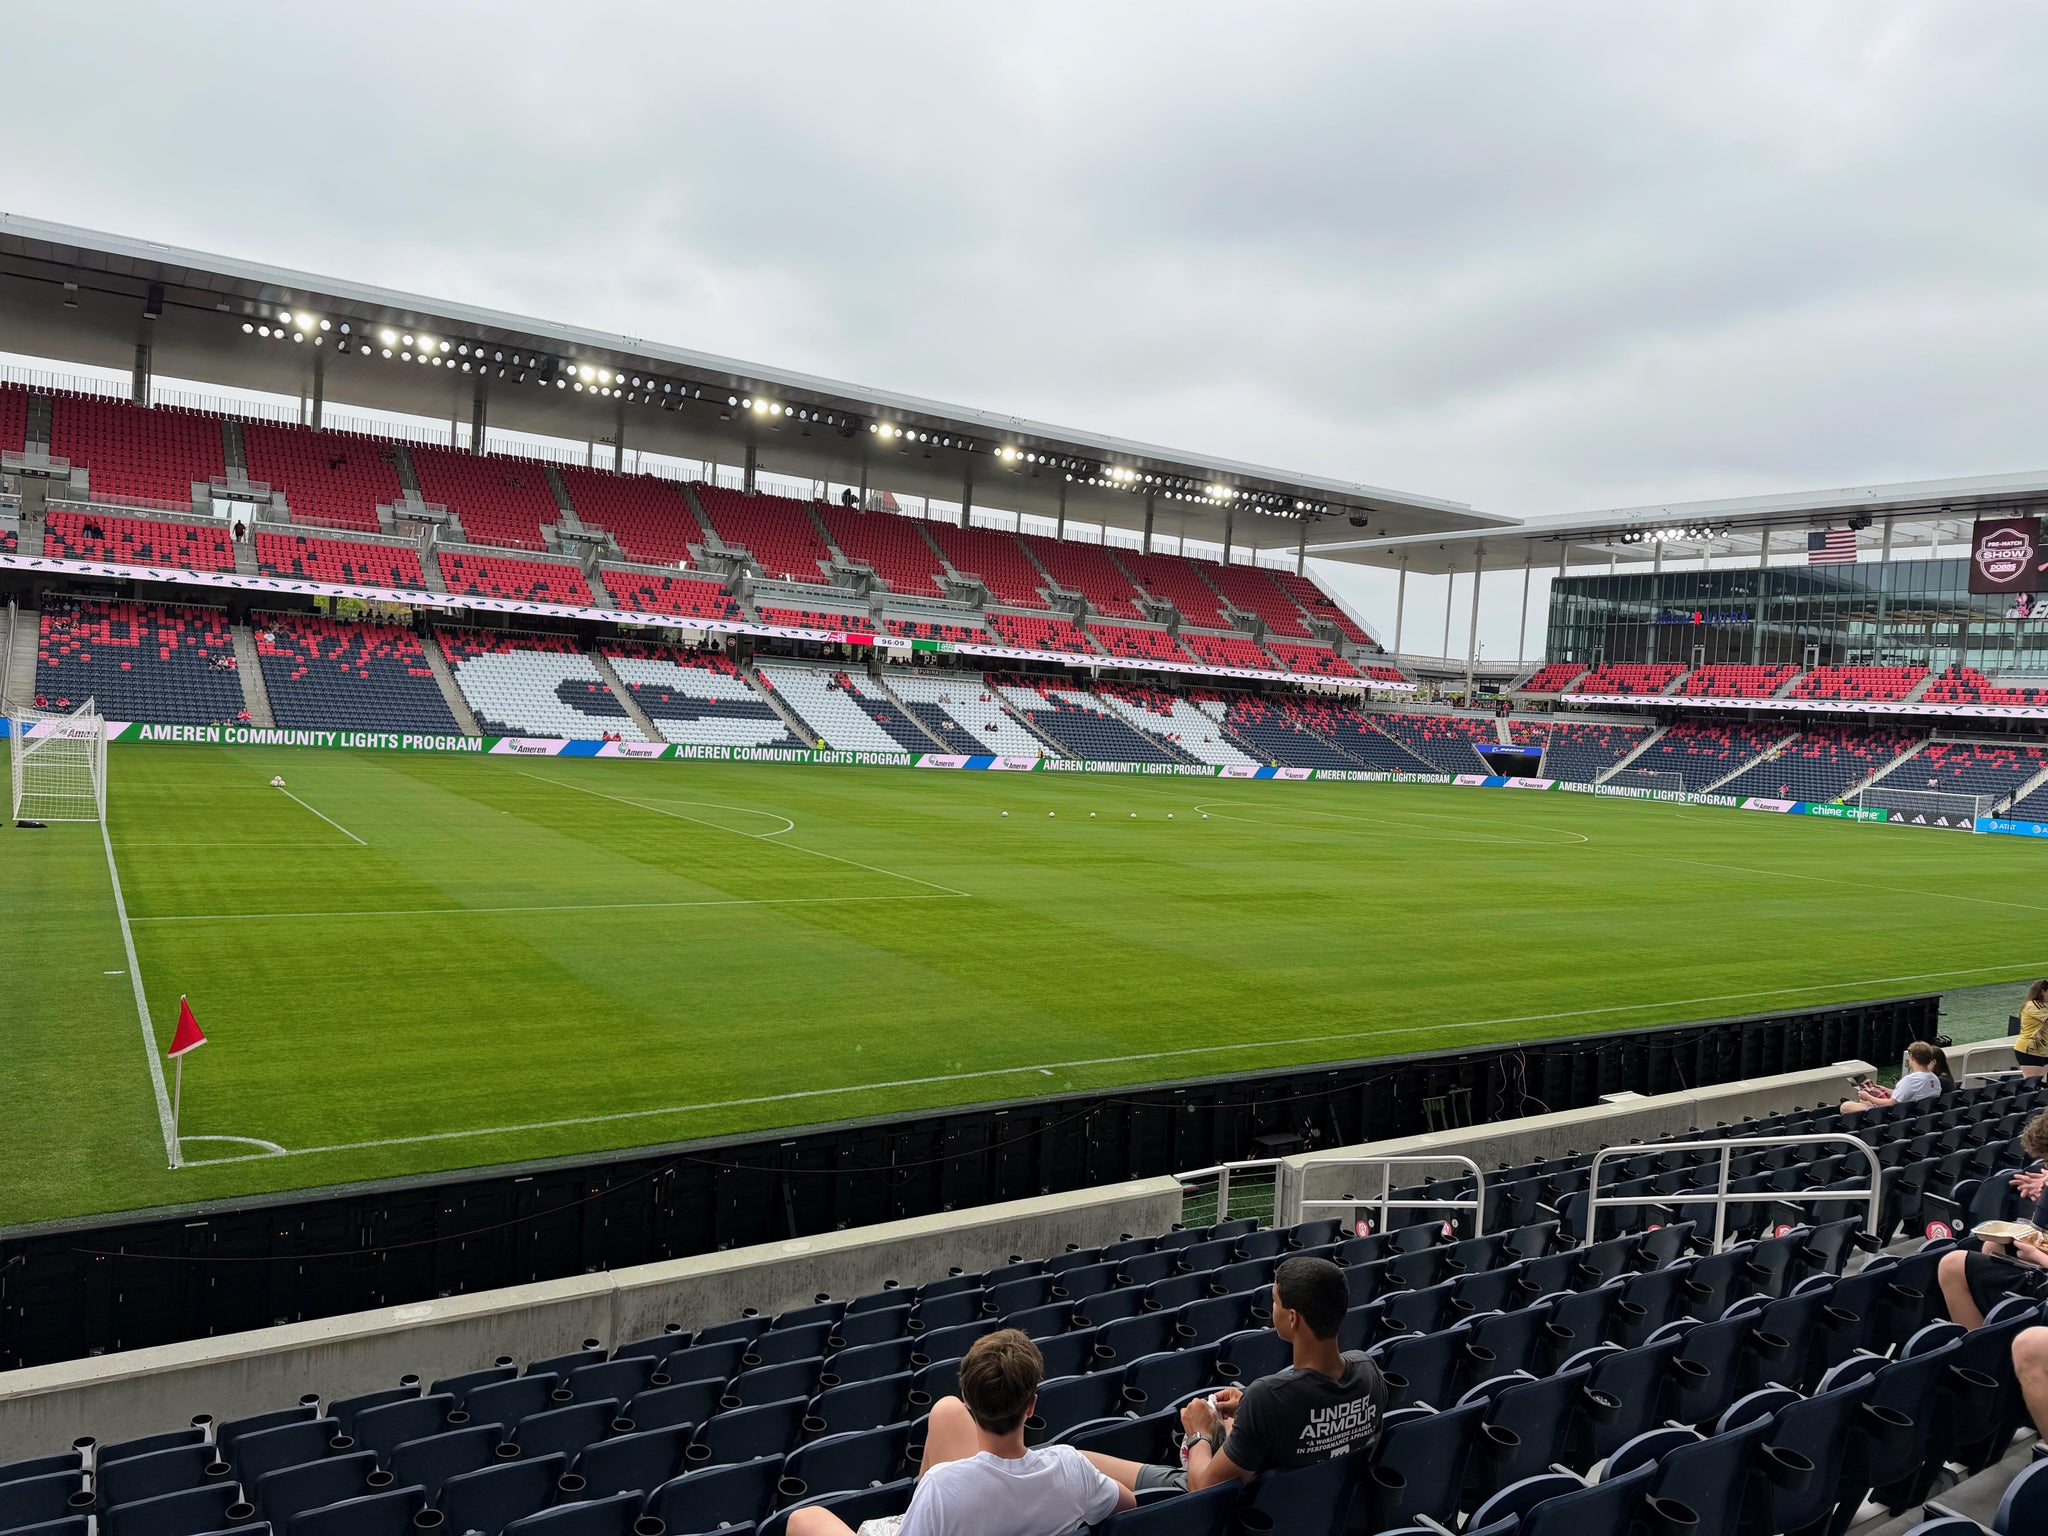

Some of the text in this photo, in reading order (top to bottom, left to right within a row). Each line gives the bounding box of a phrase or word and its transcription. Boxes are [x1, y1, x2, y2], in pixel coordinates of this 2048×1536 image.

[1983, 550, 2026, 559] SHOW
[67, 729, 98, 738] Amee
[140, 724, 483, 751] AMEREN COMMUNITY LIGHTS PROGRAM
[517, 744, 547, 754] Ameren
[626, 748, 653, 757] Ameren
[675, 745, 911, 766] AMEREN COMMUNITY LIGHTS PROGRAM
[935, 759, 955, 767] Ameren
[1009, 762, 1028, 770] Ameren
[1043, 759, 1215, 776] AMEREN COMMUNITY LIGHTS PROGRAM
[1315, 769, 1450, 784] AMEREN COMMUNITY LIGHTS PROGRAM
[1558, 781, 1737, 806] AMEREN COMMUNITY LIGHTS PROGRAM
[1812, 805, 1842, 816] chime
[1310, 1394, 1371, 1423] UNDER
[1299, 1404, 1377, 1439] ARMOUR
[1306, 1436, 1350, 1454] PERFORMANCE
